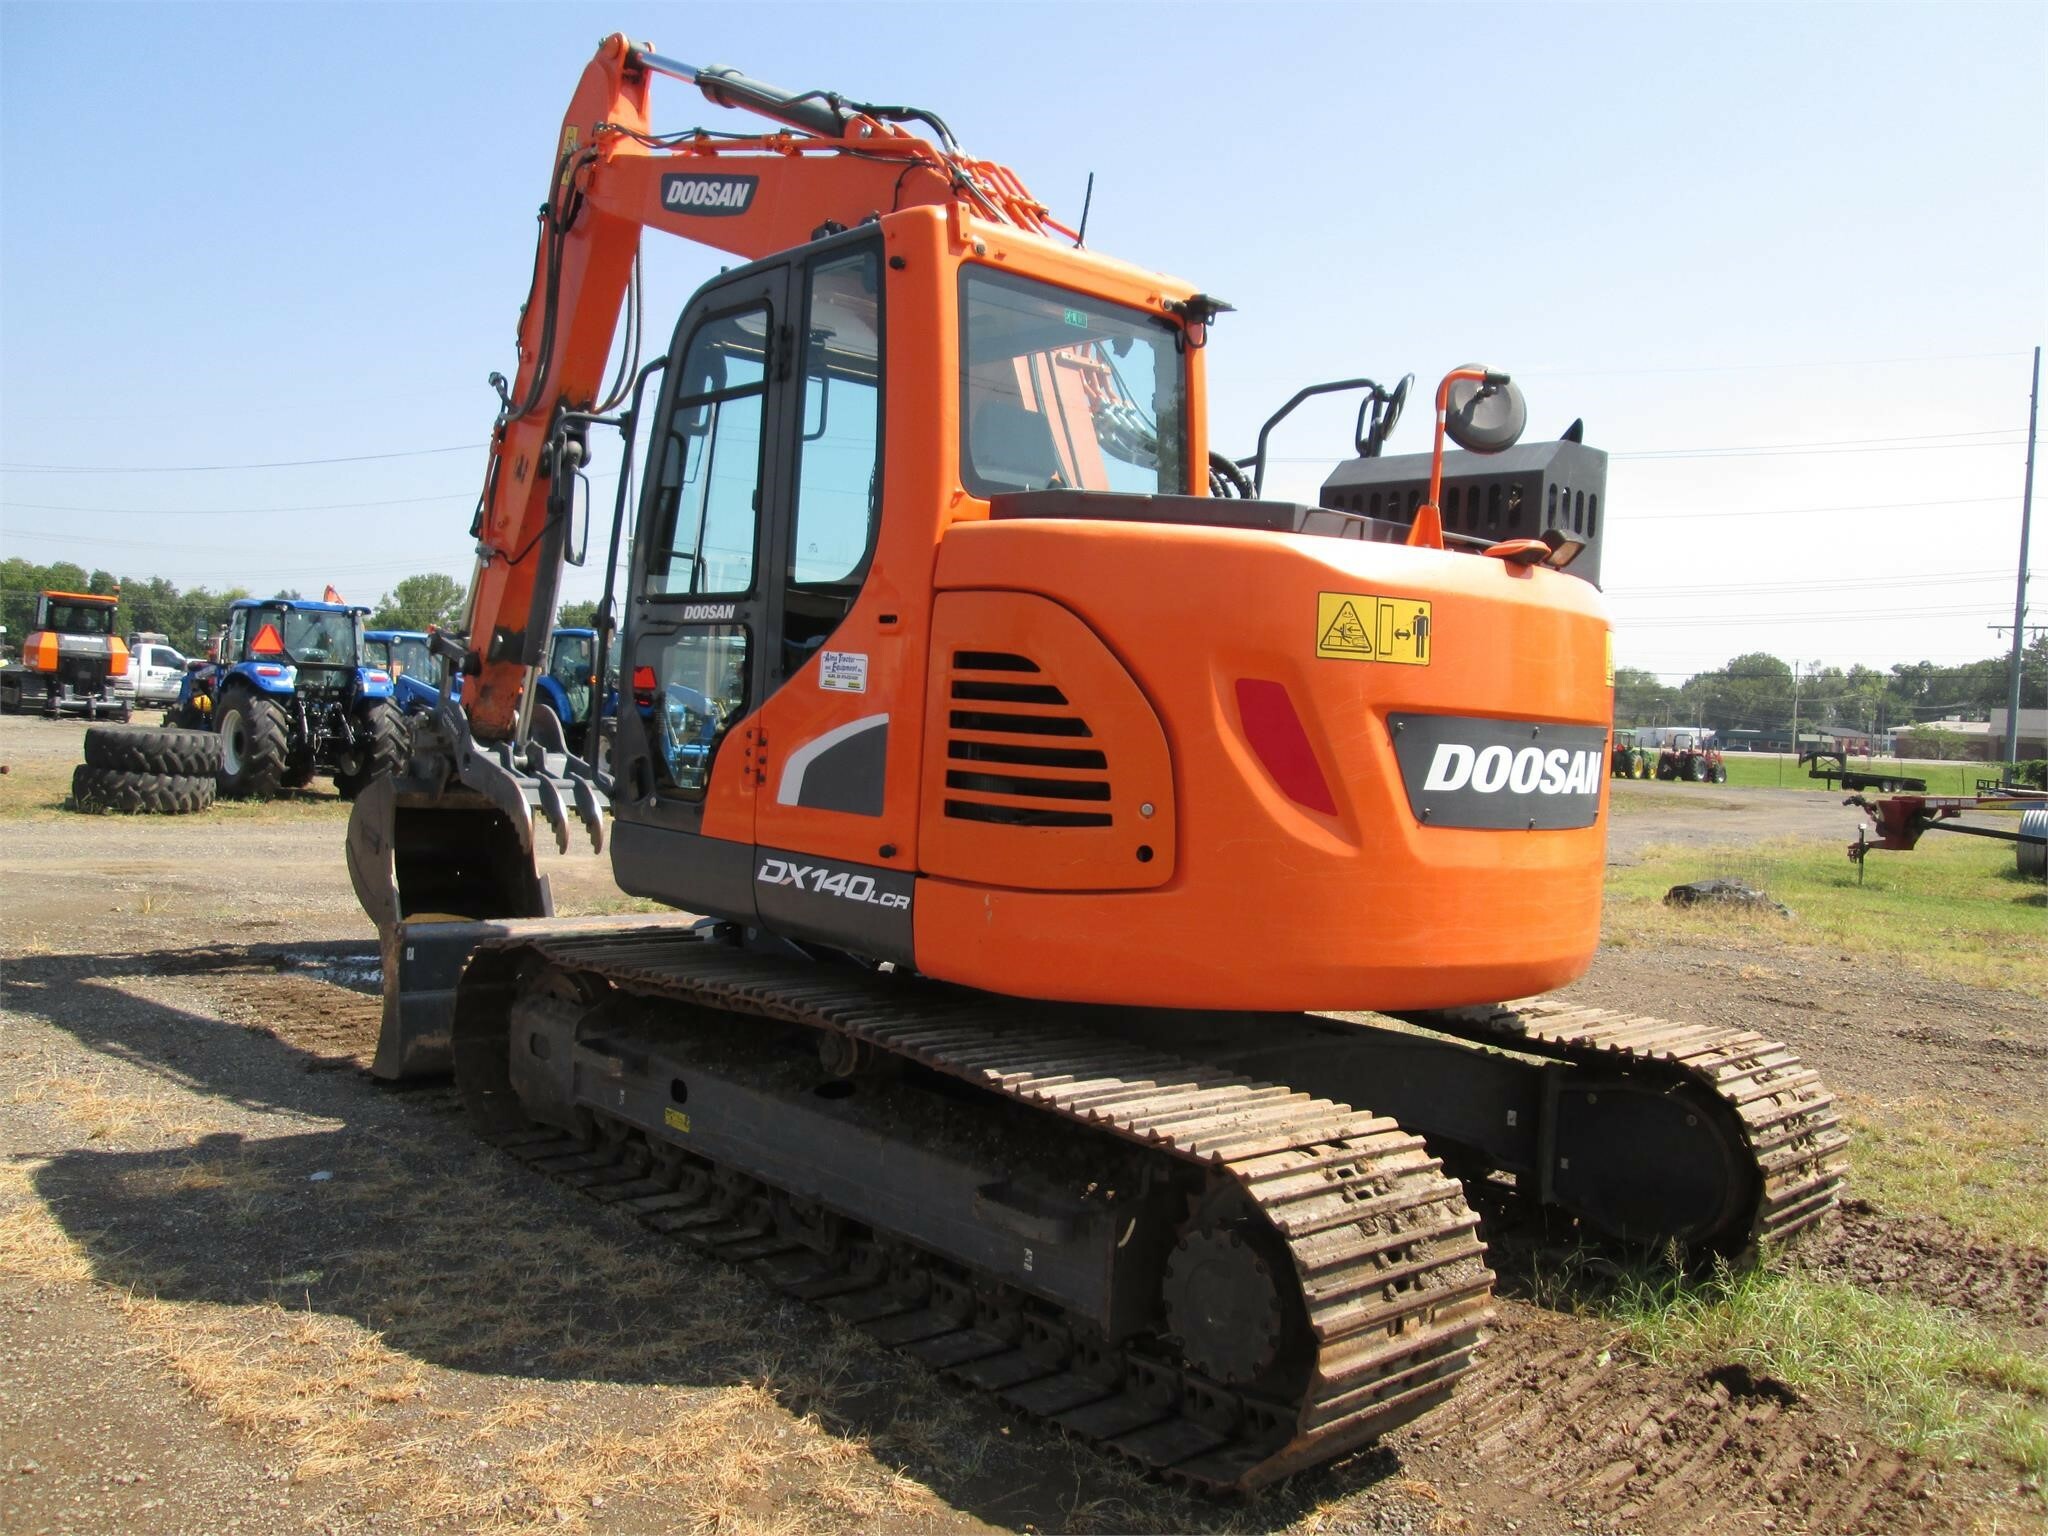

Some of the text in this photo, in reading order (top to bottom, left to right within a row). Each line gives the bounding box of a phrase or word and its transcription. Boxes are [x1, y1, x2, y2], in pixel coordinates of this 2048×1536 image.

[666, 181, 750, 207] DOOSAN
[684, 604, 735, 619] DOOSAN
[1423, 743, 1602, 795] DOOSAN
